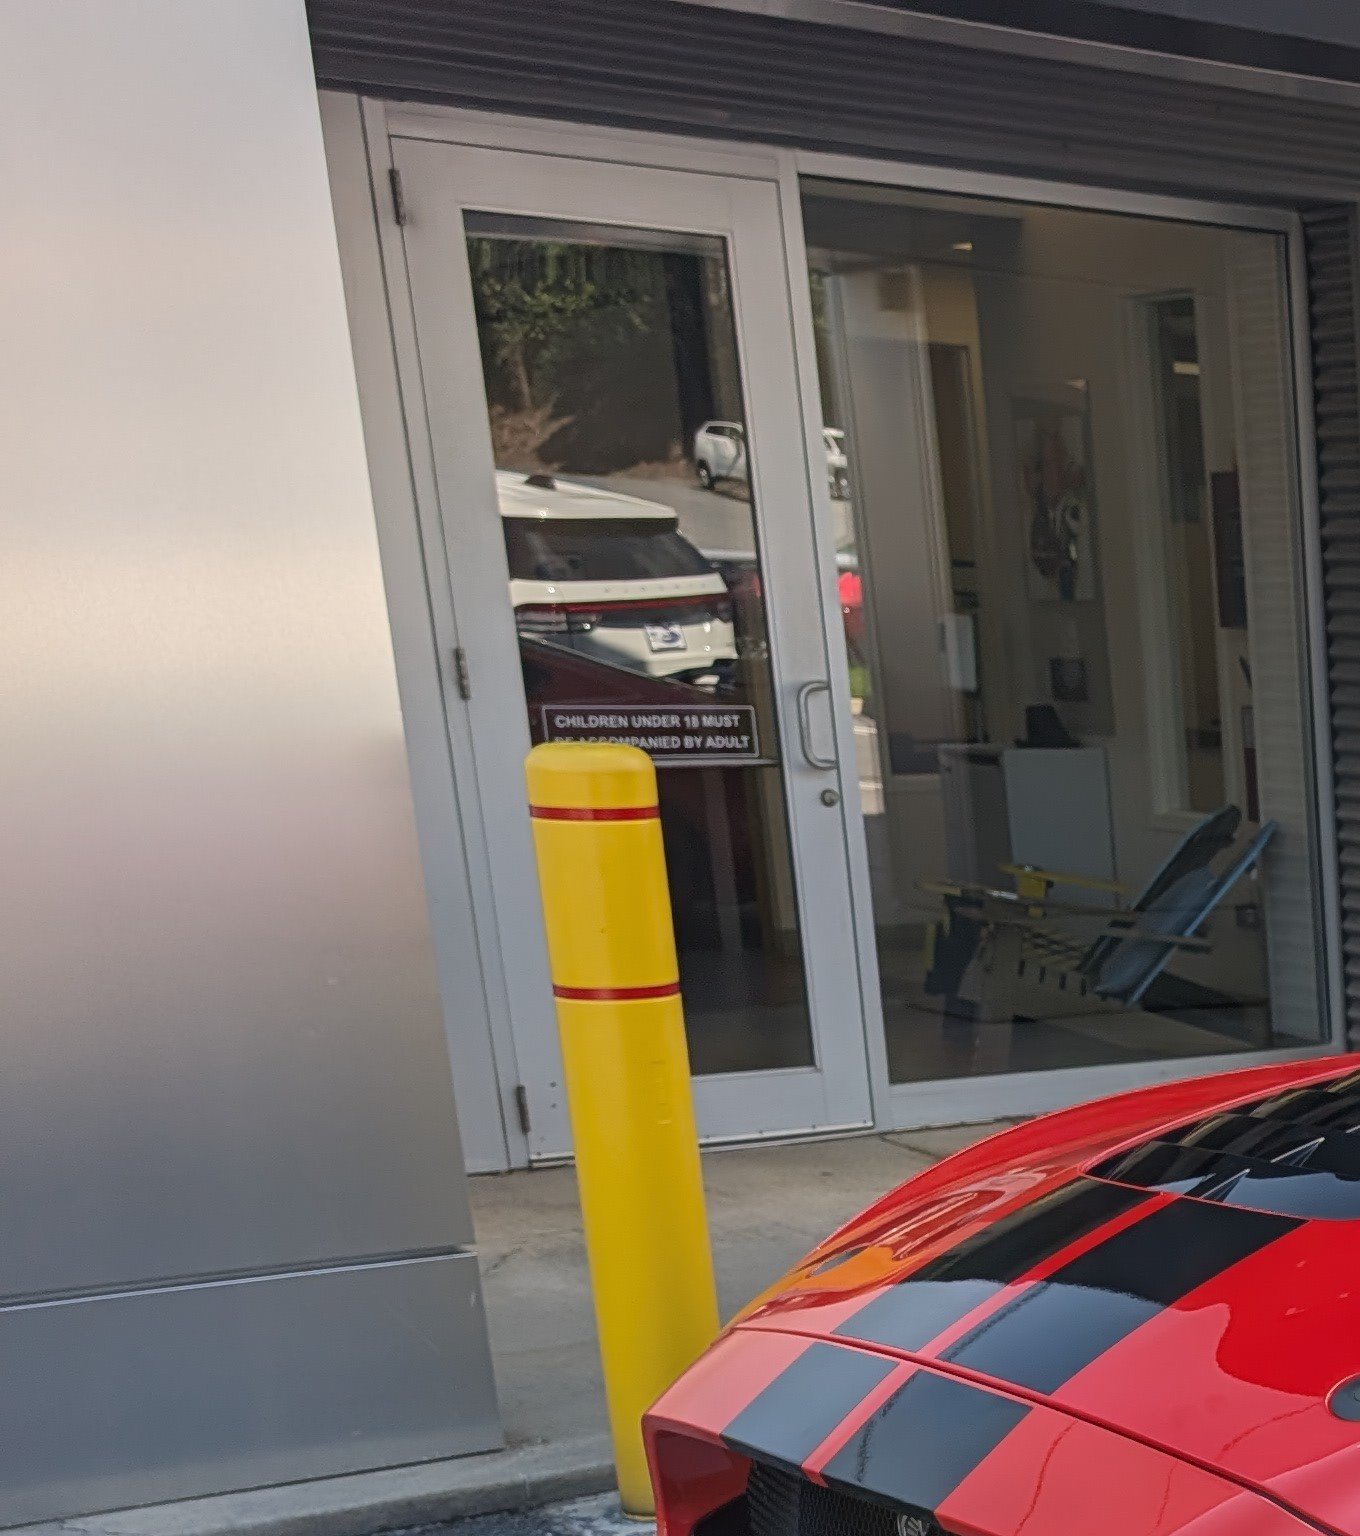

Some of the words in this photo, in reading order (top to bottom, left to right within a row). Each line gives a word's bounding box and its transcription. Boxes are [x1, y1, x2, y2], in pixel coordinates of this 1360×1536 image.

[553, 714, 629, 728] CHILDREN
[631, 714, 681, 728] UNDER
[702, 714, 740, 728] MUST
[683, 735, 703, 748] BY
[705, 735, 751, 748] ADULT
